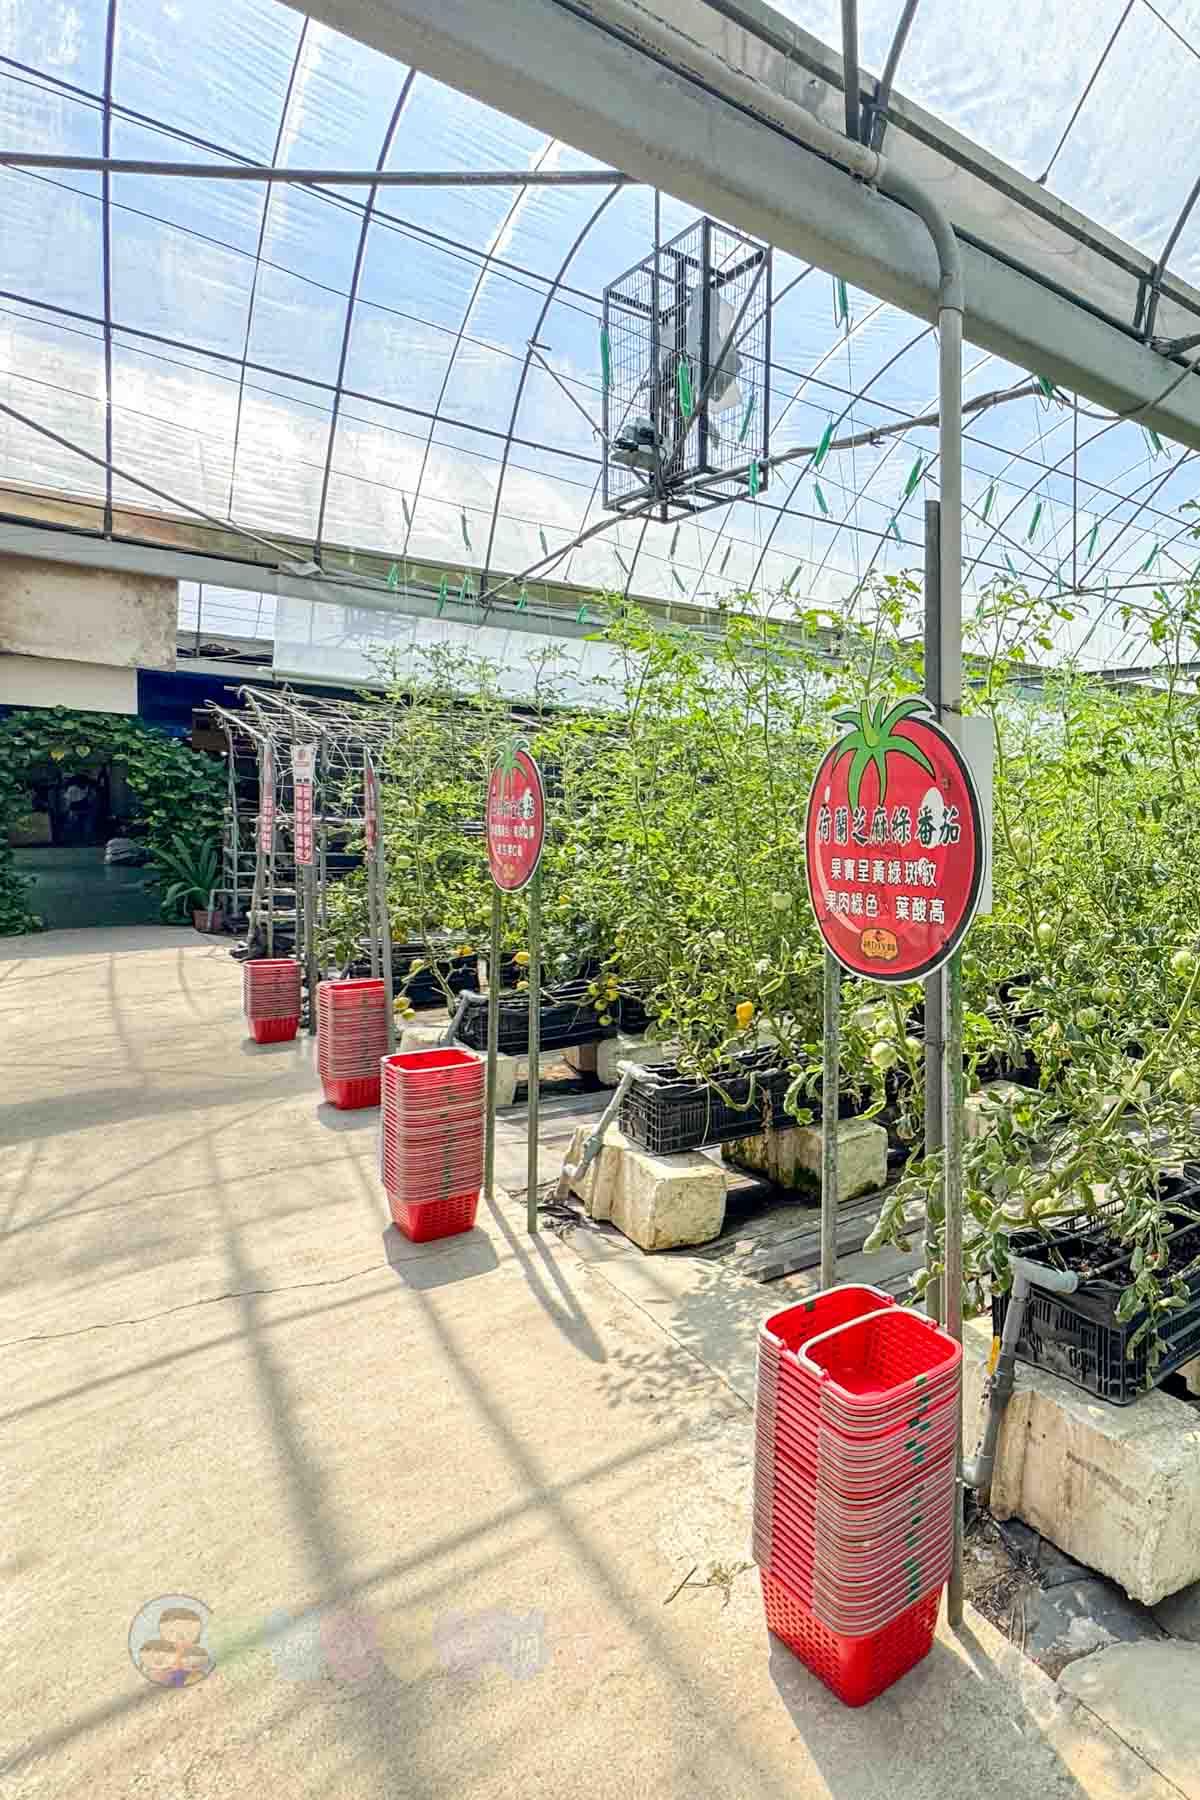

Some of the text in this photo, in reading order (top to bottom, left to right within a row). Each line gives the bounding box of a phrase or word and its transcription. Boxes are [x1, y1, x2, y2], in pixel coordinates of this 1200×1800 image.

[825, 890, 945, 924] 果肉綠色 葉酸高
